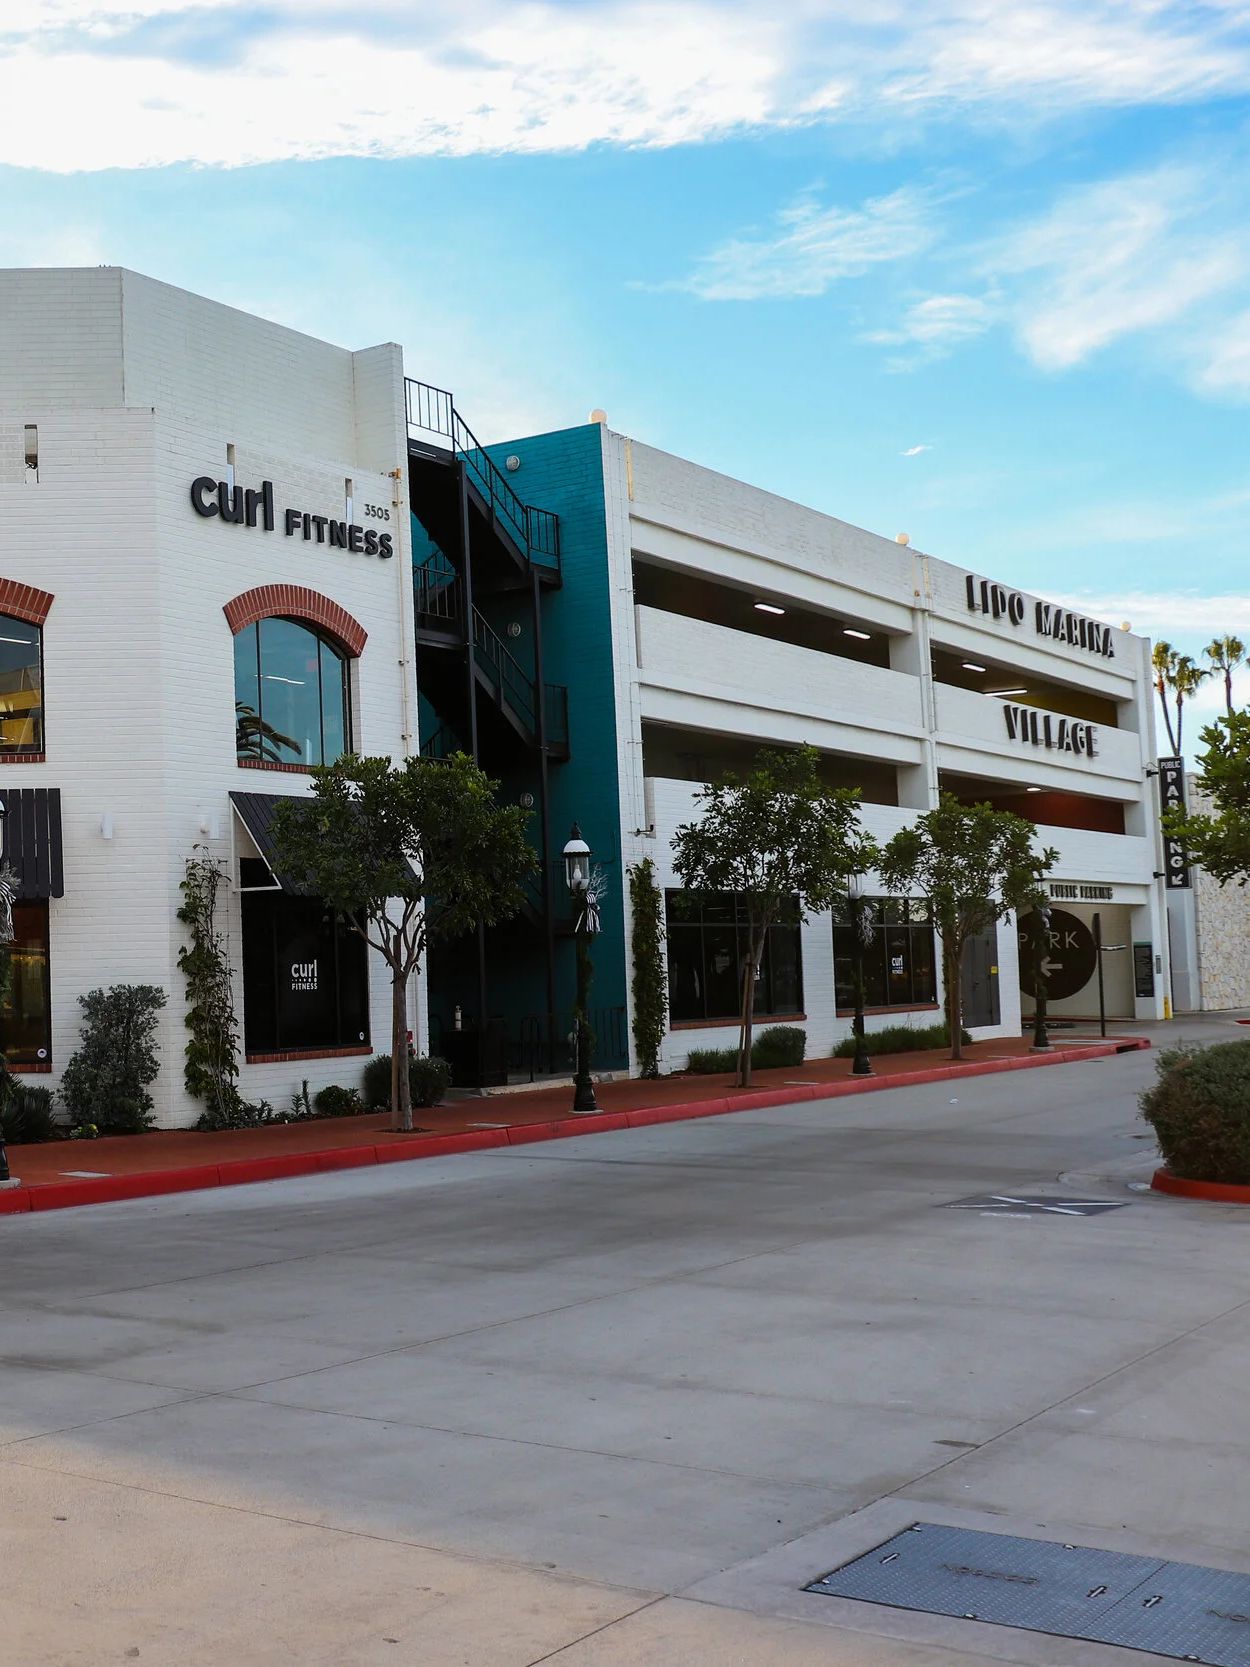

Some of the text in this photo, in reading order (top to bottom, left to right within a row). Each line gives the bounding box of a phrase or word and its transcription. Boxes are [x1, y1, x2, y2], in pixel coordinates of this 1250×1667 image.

[191, 476, 393, 559] curl FITNESS
[364, 503, 391, 521] 3505
[966, 575, 1115, 658] LIDO MARINA
[1003, 704, 1099, 757] VILLAGE
[1160, 761, 1181, 769] PUBLIC
[1166, 771, 1185, 868] PARNG
[1018, 931, 1079, 949] PRK
[291, 959, 317, 977] curl
